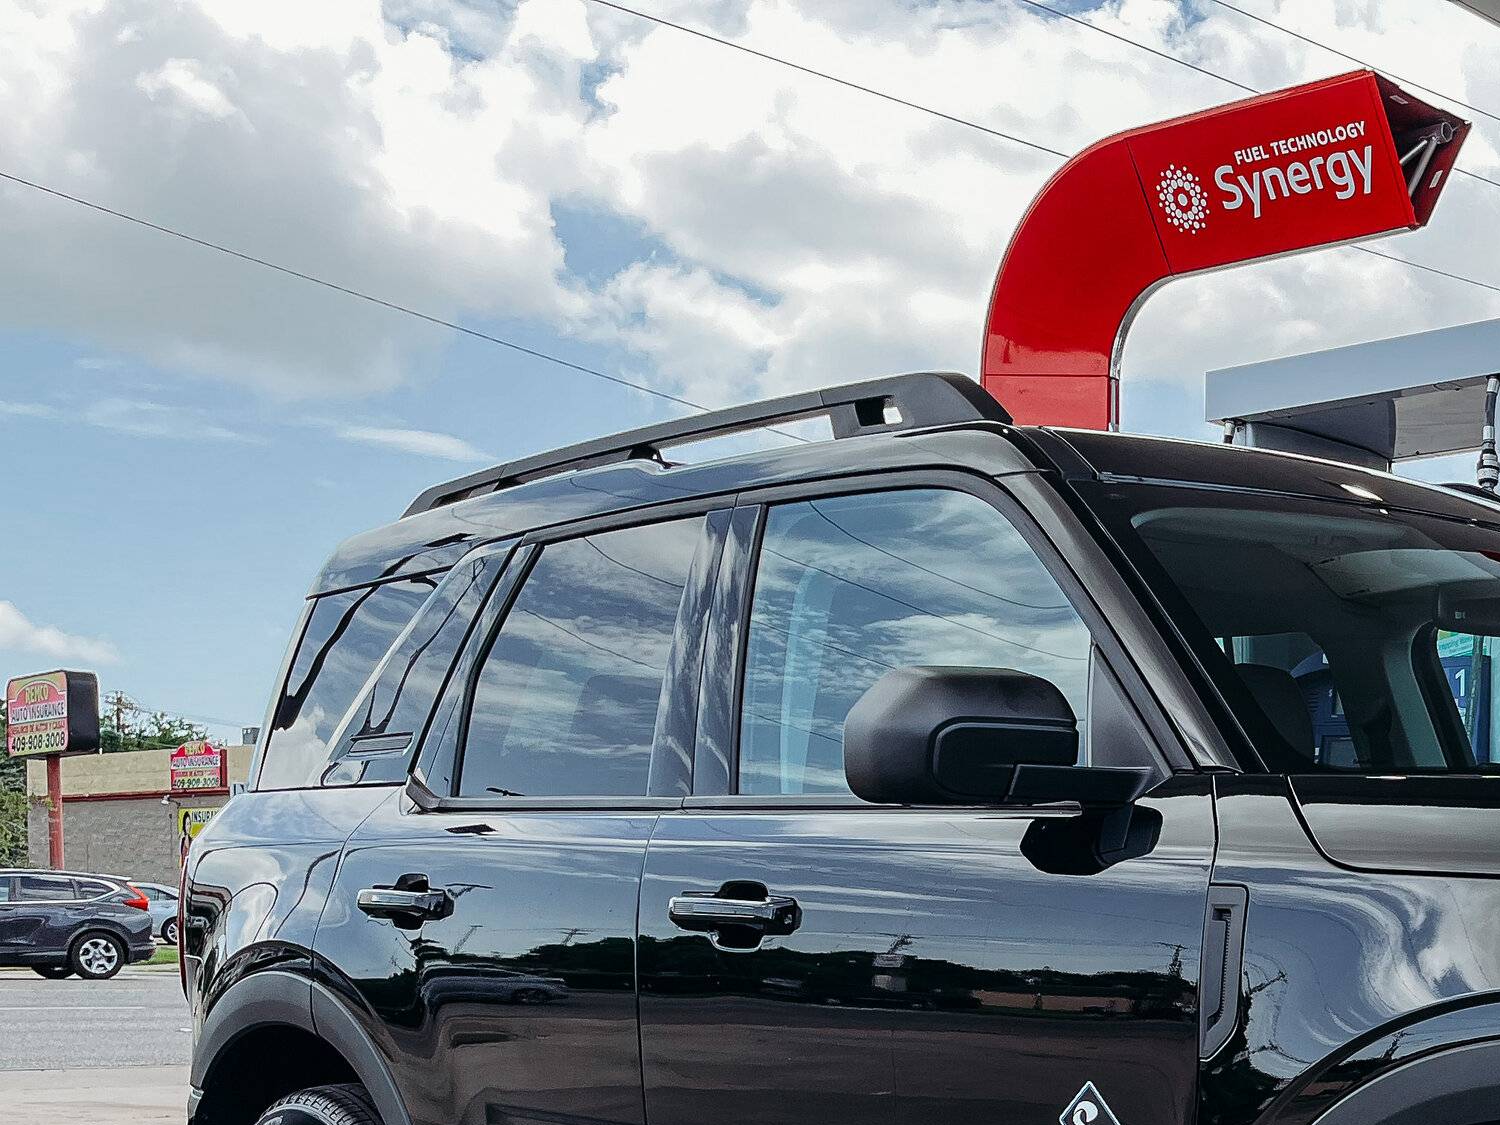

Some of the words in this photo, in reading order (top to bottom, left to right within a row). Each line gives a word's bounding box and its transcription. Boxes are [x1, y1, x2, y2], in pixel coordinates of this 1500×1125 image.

[1234, 145, 1270, 166] FUEL
[1271, 120, 1366, 158] TECHNOLOGY
[1215, 145, 1373, 218] Synergy
[1455, 669, 1466, 696] 1
[11, 706, 27, 723] AUTO
[28, 702, 64, 719] INSURANCE
[11, 731, 66, 752] 409-908-3008
